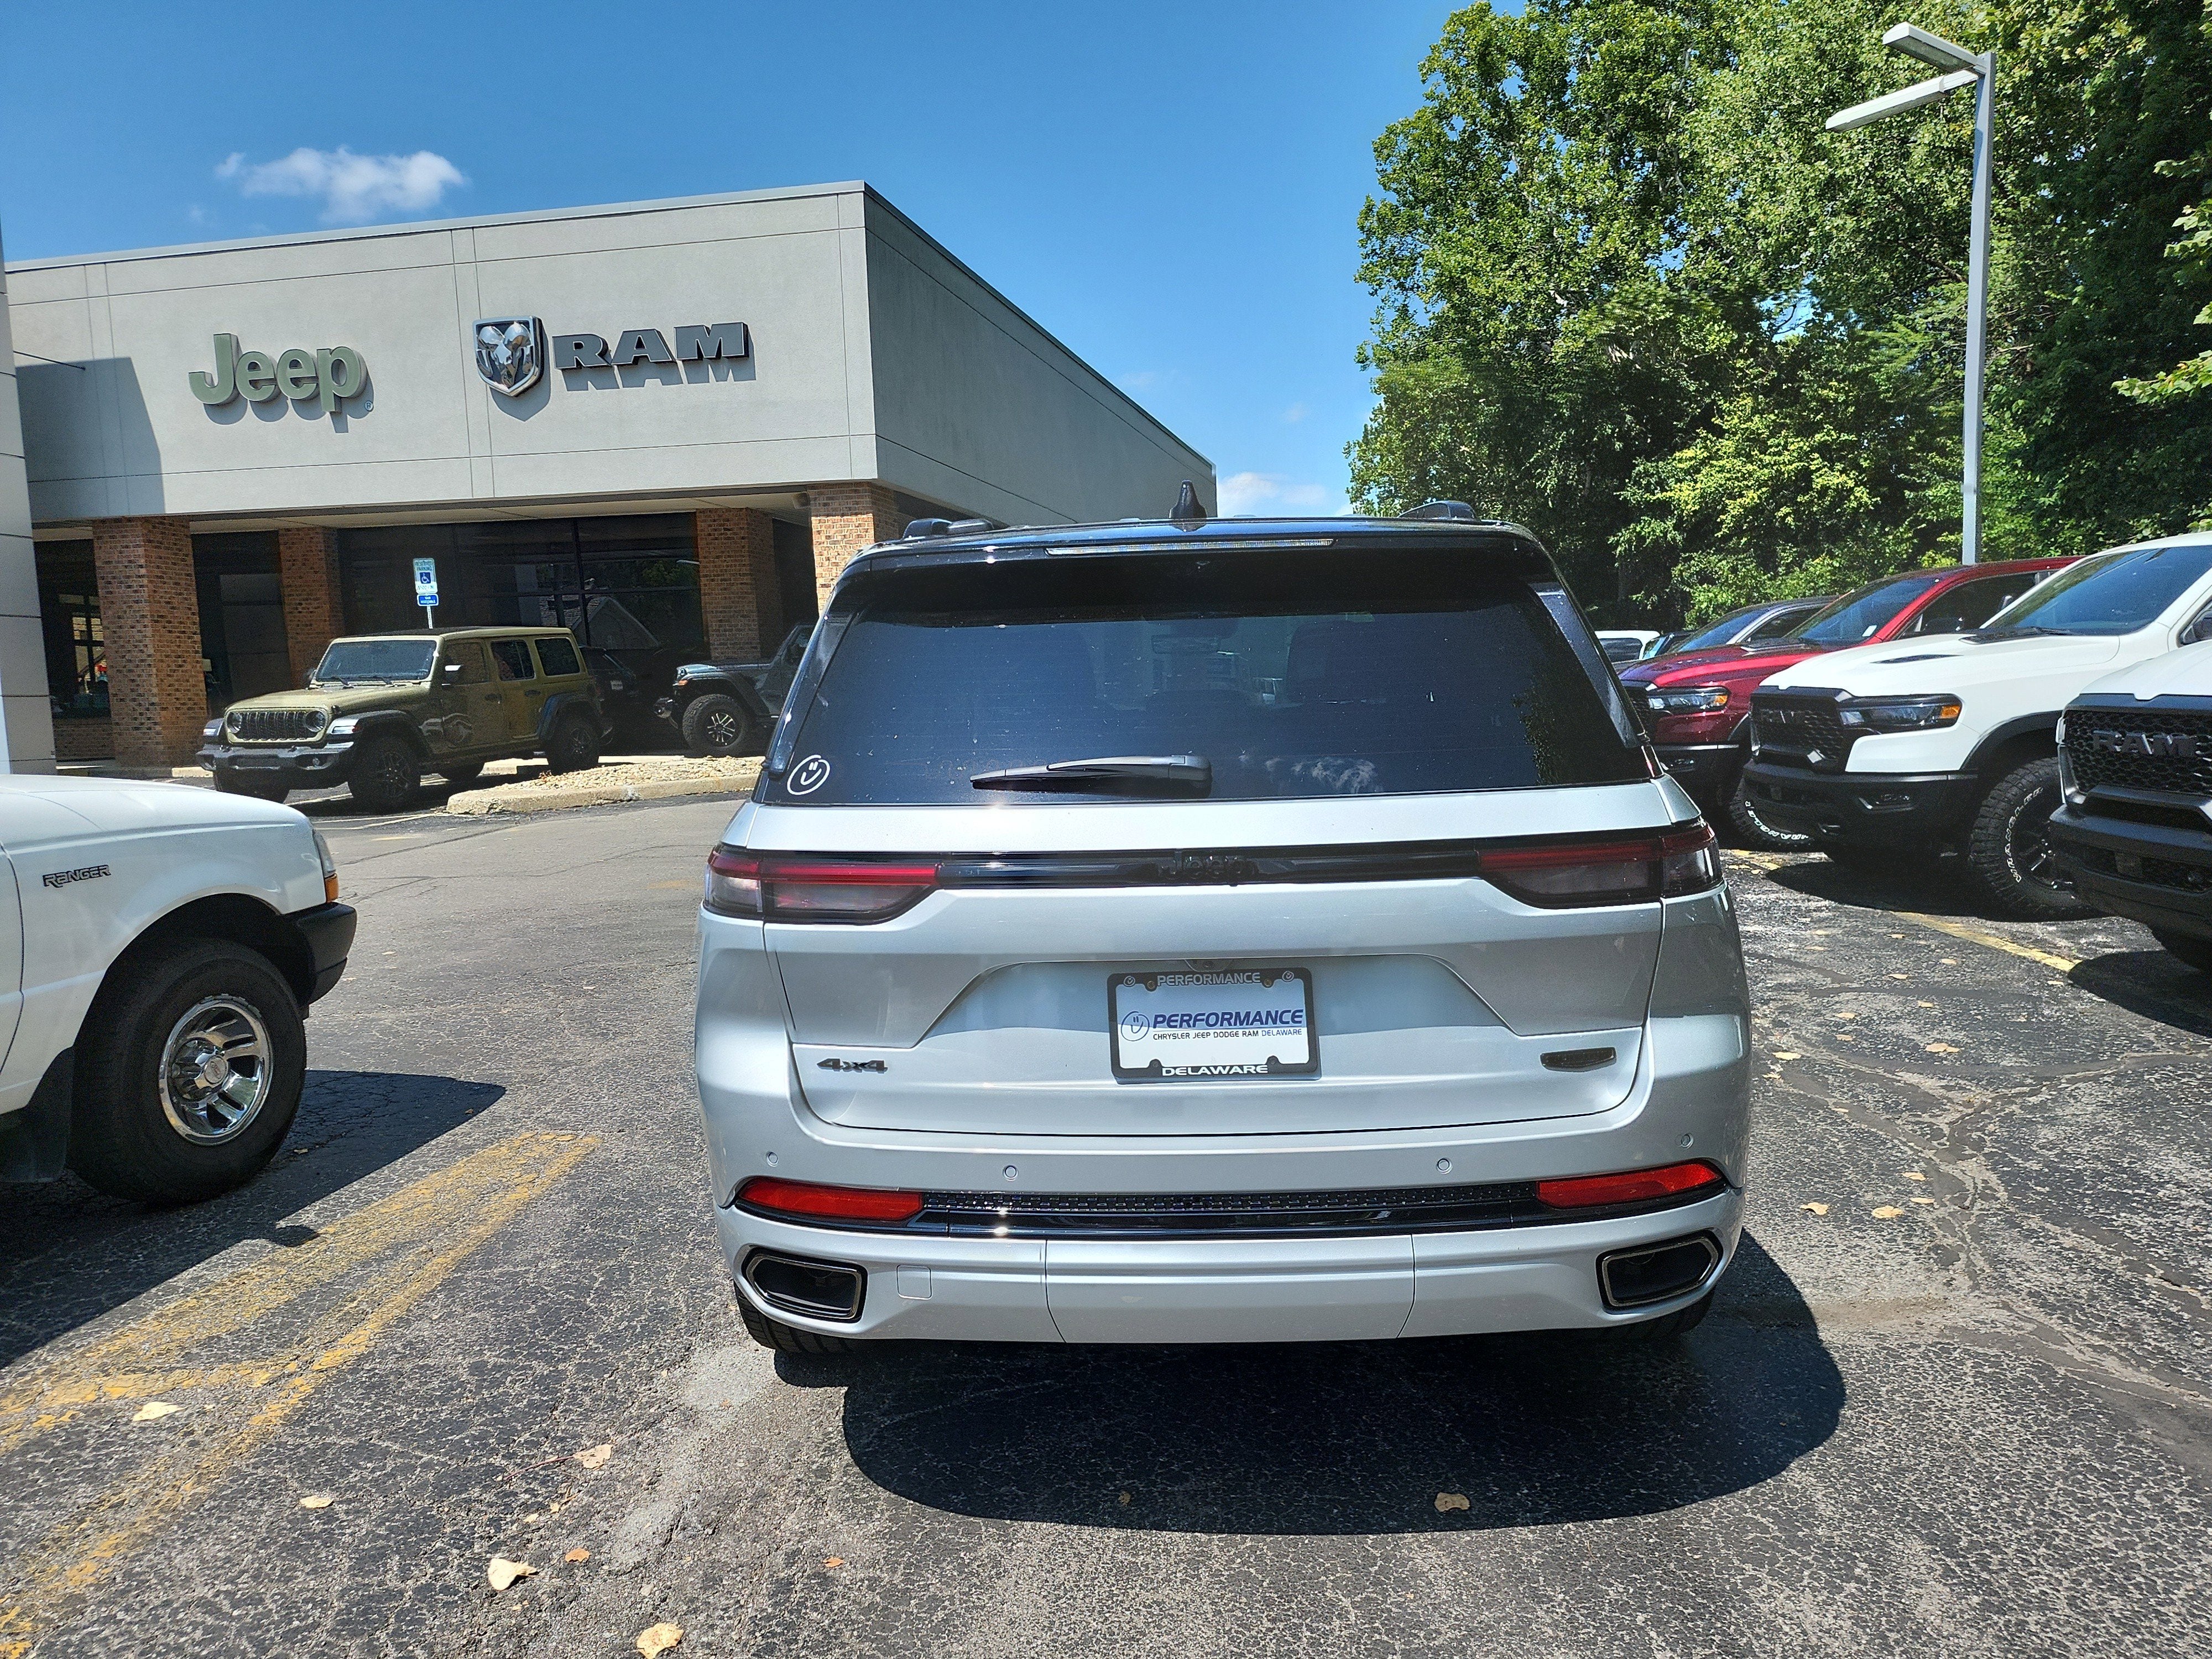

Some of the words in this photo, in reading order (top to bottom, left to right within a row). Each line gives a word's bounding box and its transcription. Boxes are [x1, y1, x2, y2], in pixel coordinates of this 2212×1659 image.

[552, 322, 749, 369] RAM
[188, 333, 367, 415] Jeep
[2093, 728, 2197, 755] RAM
[43, 864, 111, 888] RANGER
[1157, 972, 1261, 987] PERFORMANCE
[1152, 1009, 1304, 1029] PERFORMANCE
[816, 1058, 888, 1073] 4x4
[1162, 1064, 1269, 1077] DELAWARE
